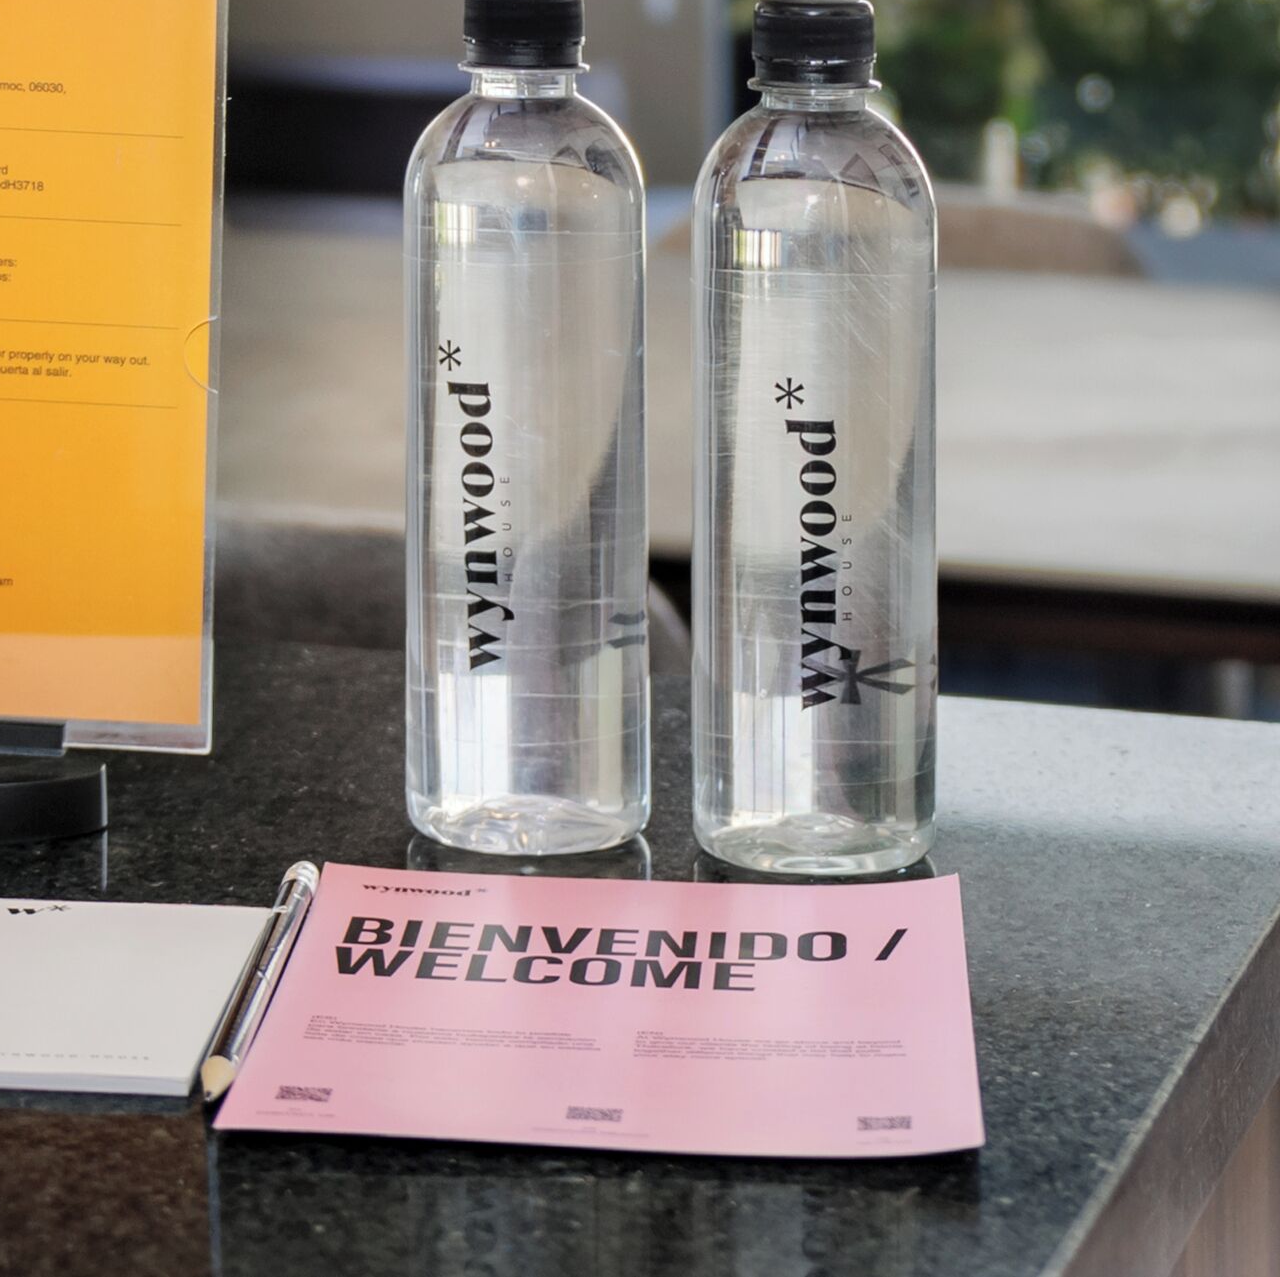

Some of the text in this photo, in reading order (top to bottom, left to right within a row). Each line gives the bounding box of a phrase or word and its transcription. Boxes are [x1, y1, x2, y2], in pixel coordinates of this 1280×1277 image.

[28, 81, 66, 94] 06030,
[8, 350, 54, 363] properly
[58, 353, 72, 361] on
[75, 354, 101, 365] your
[103, 355, 127, 366] way
[129, 356, 151, 366] out.
[32, 366, 42, 375] al
[45, 367, 72, 378] salir.
[499, 474, 514, 582] HOUSE
[841, 513, 853, 622] HOUSE
[343, 915, 849, 963] BIENVENIDO
[336, 947, 756, 991] WELCOME
